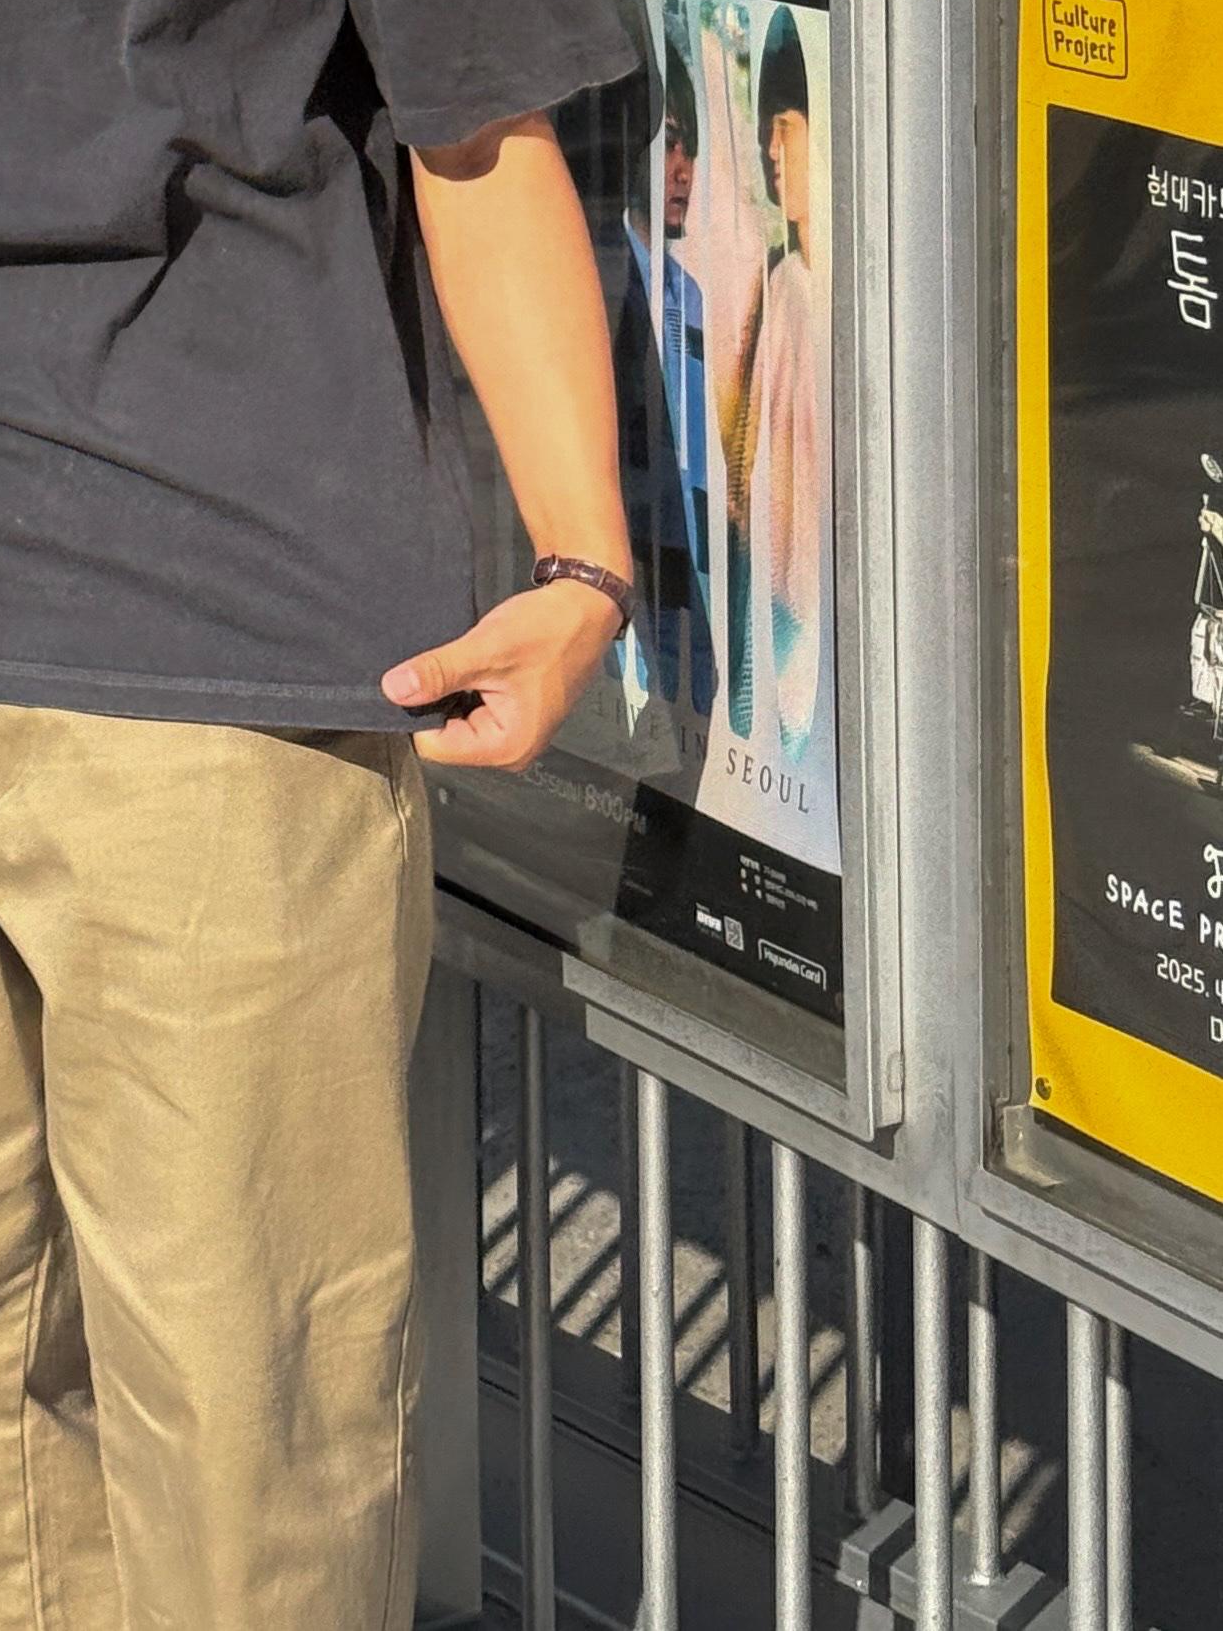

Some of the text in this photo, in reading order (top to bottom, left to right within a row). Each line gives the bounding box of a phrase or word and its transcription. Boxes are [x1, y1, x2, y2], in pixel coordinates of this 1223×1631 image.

[1052, 0, 1117, 38] Culture
[1054, 30, 1116, 64] Project
[1147, 164, 1223, 220] 현대카
[726, 747, 809, 814] SEOUL
[1105, 873, 1185, 930] SPACE
